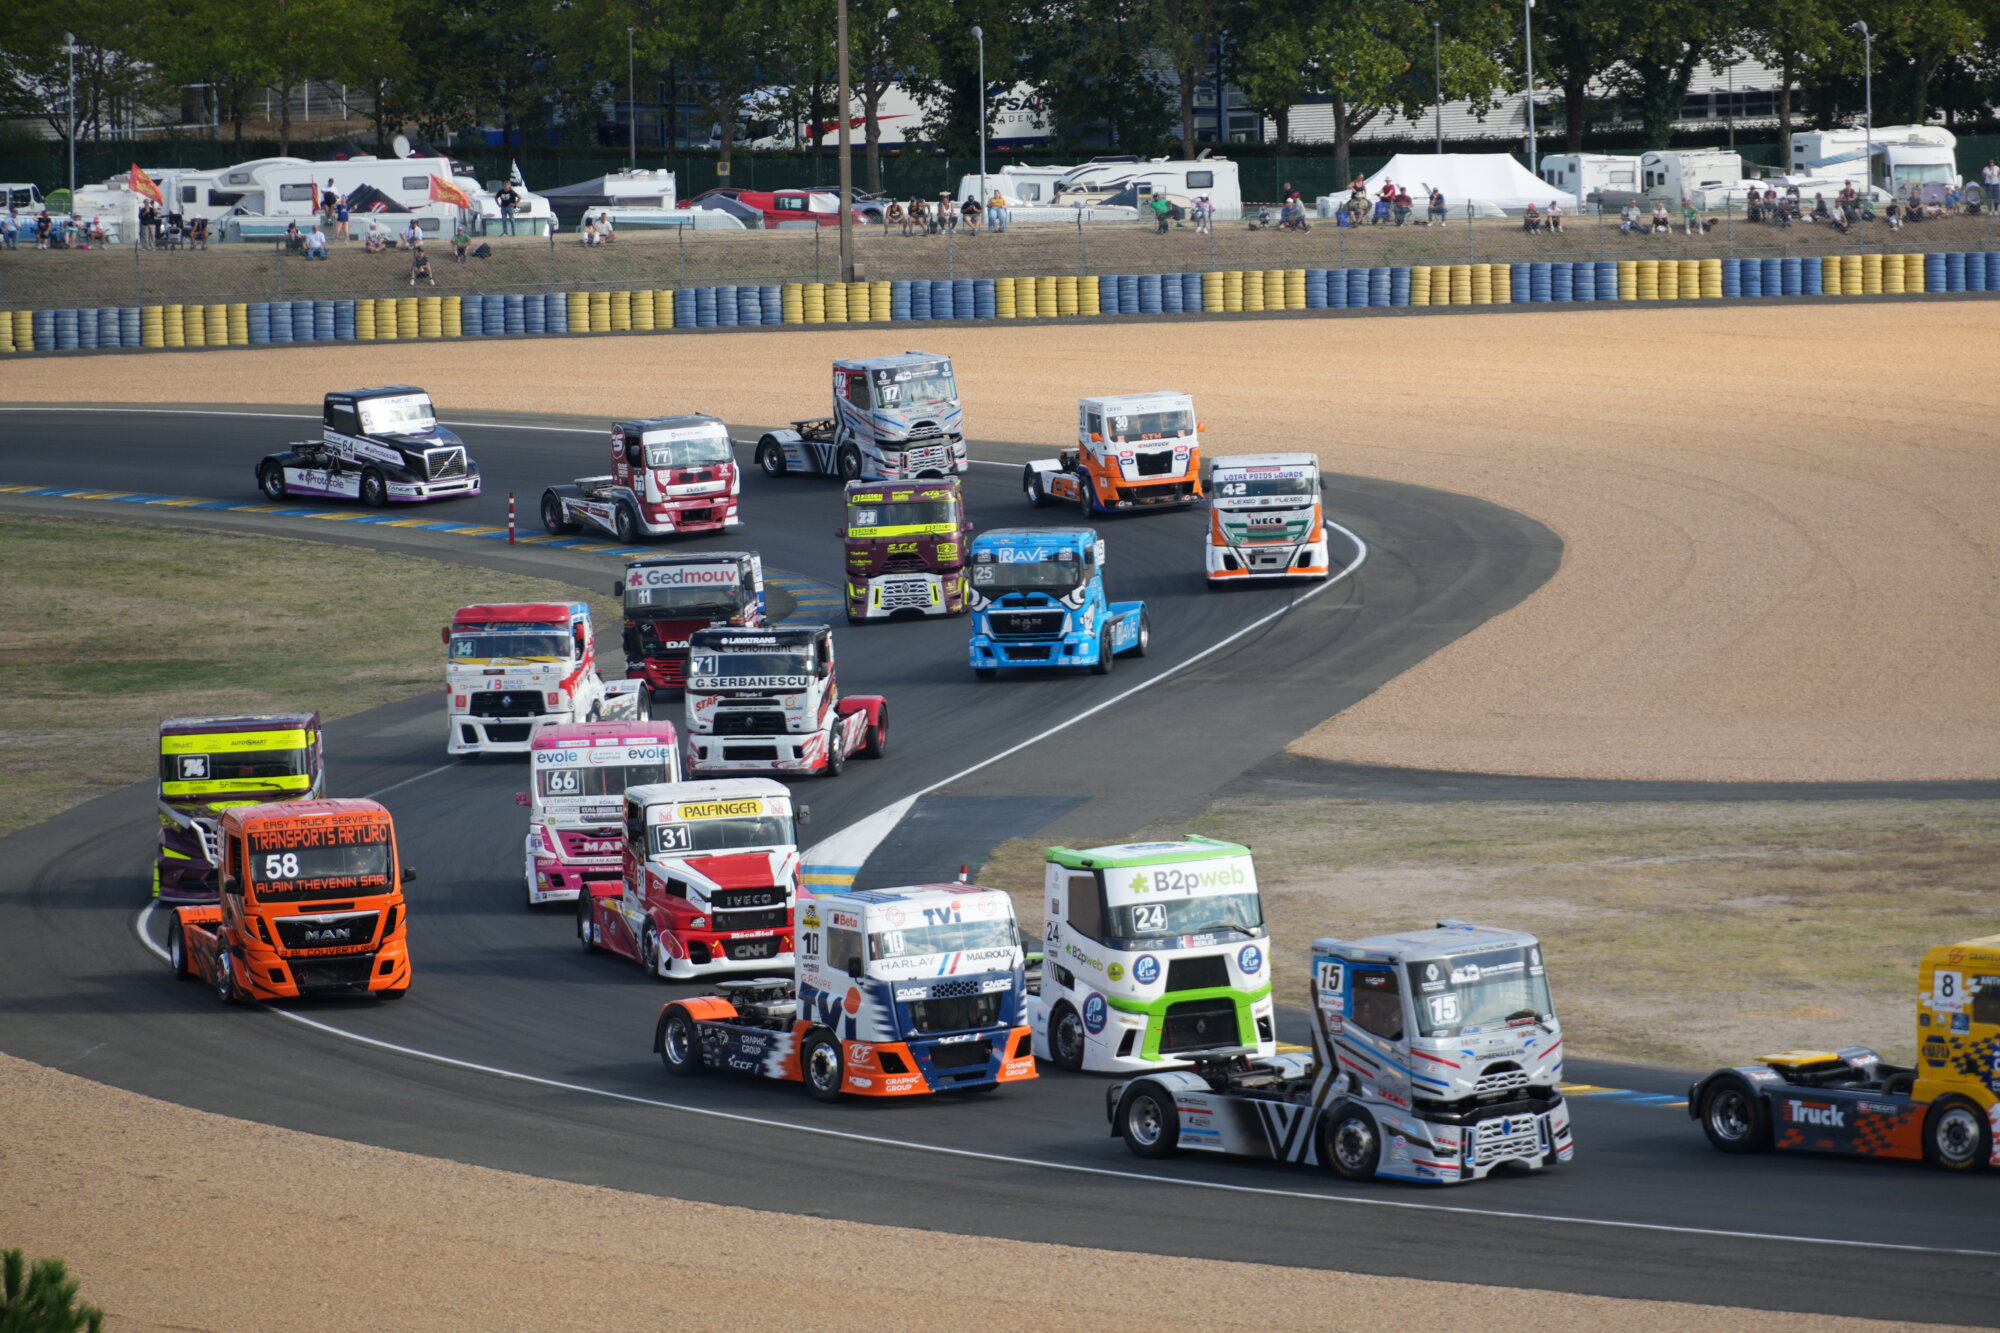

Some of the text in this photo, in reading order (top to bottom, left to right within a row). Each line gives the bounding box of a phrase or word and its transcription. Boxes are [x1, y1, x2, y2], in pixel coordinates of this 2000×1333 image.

[884, 387, 898, 401] 17
[1115, 416, 1128, 429] 30
[342, 439, 354, 453] 64
[653, 450, 668, 463] 77
[305, 472, 345, 489] eProtocole
[1222, 482, 1247, 496] 42
[1251, 517, 1283, 525] IVECO
[999, 547, 1048, 563] RAVE
[646, 568, 737, 586] Gedmouv
[976, 566, 993, 580] 25
[638, 589, 651, 605] 11
[1010, 617, 1042, 628] MAN
[456, 641, 473, 656] 14
[666, 640, 690, 649] DA
[694, 656, 713, 673] 71
[695, 676, 808, 688] G.SERBANESCU
[696, 695, 718, 712] STAF
[550, 771, 576, 790] 66
[683, 802, 758, 818] PALFINGER
[263, 815, 373, 830] EASY TRUCK SERVICE
[252, 824, 386, 850] TRANSPORTS ARTURO
[662, 827, 688, 849] 31
[265, 852, 299, 879] 58
[256, 880, 293, 893] ALAIN
[298, 877, 357, 890] THEVENIN
[1153, 865, 1245, 895] B2pweb
[725, 894, 772, 906] IVECO
[840, 914, 858, 928] Beta
[1135, 904, 1165, 930] 24
[304, 927, 351, 942] MAN
[1046, 921, 1060, 943] 24
[802, 932, 819, 955] 10
[883, 930, 905, 953] 10
[306, 944, 377, 956] COUVERTURE
[733, 942, 768, 958] CNH
[966, 949, 1012, 961] MAUROUX
[880, 957, 936, 971] HARLAY
[1072, 945, 1105, 972] B2pweb
[800, 973, 832, 990] GROUPE
[1321, 964, 1340, 992] 15
[1941, 973, 1954, 997] 8
[1430, 995, 1457, 1021] 15
[741, 1034, 767, 1047] GRAPHIC
[741, 1045, 761, 1055] GROUP
[1006, 1061, 1033, 1070] GRAPHIC
[1006, 1068, 1028, 1077] GROUP
[885, 1075, 921, 1086] GRAPHIC
[886, 1084, 912, 1092] GROUP
[1788, 1099, 1845, 1128] Truck
